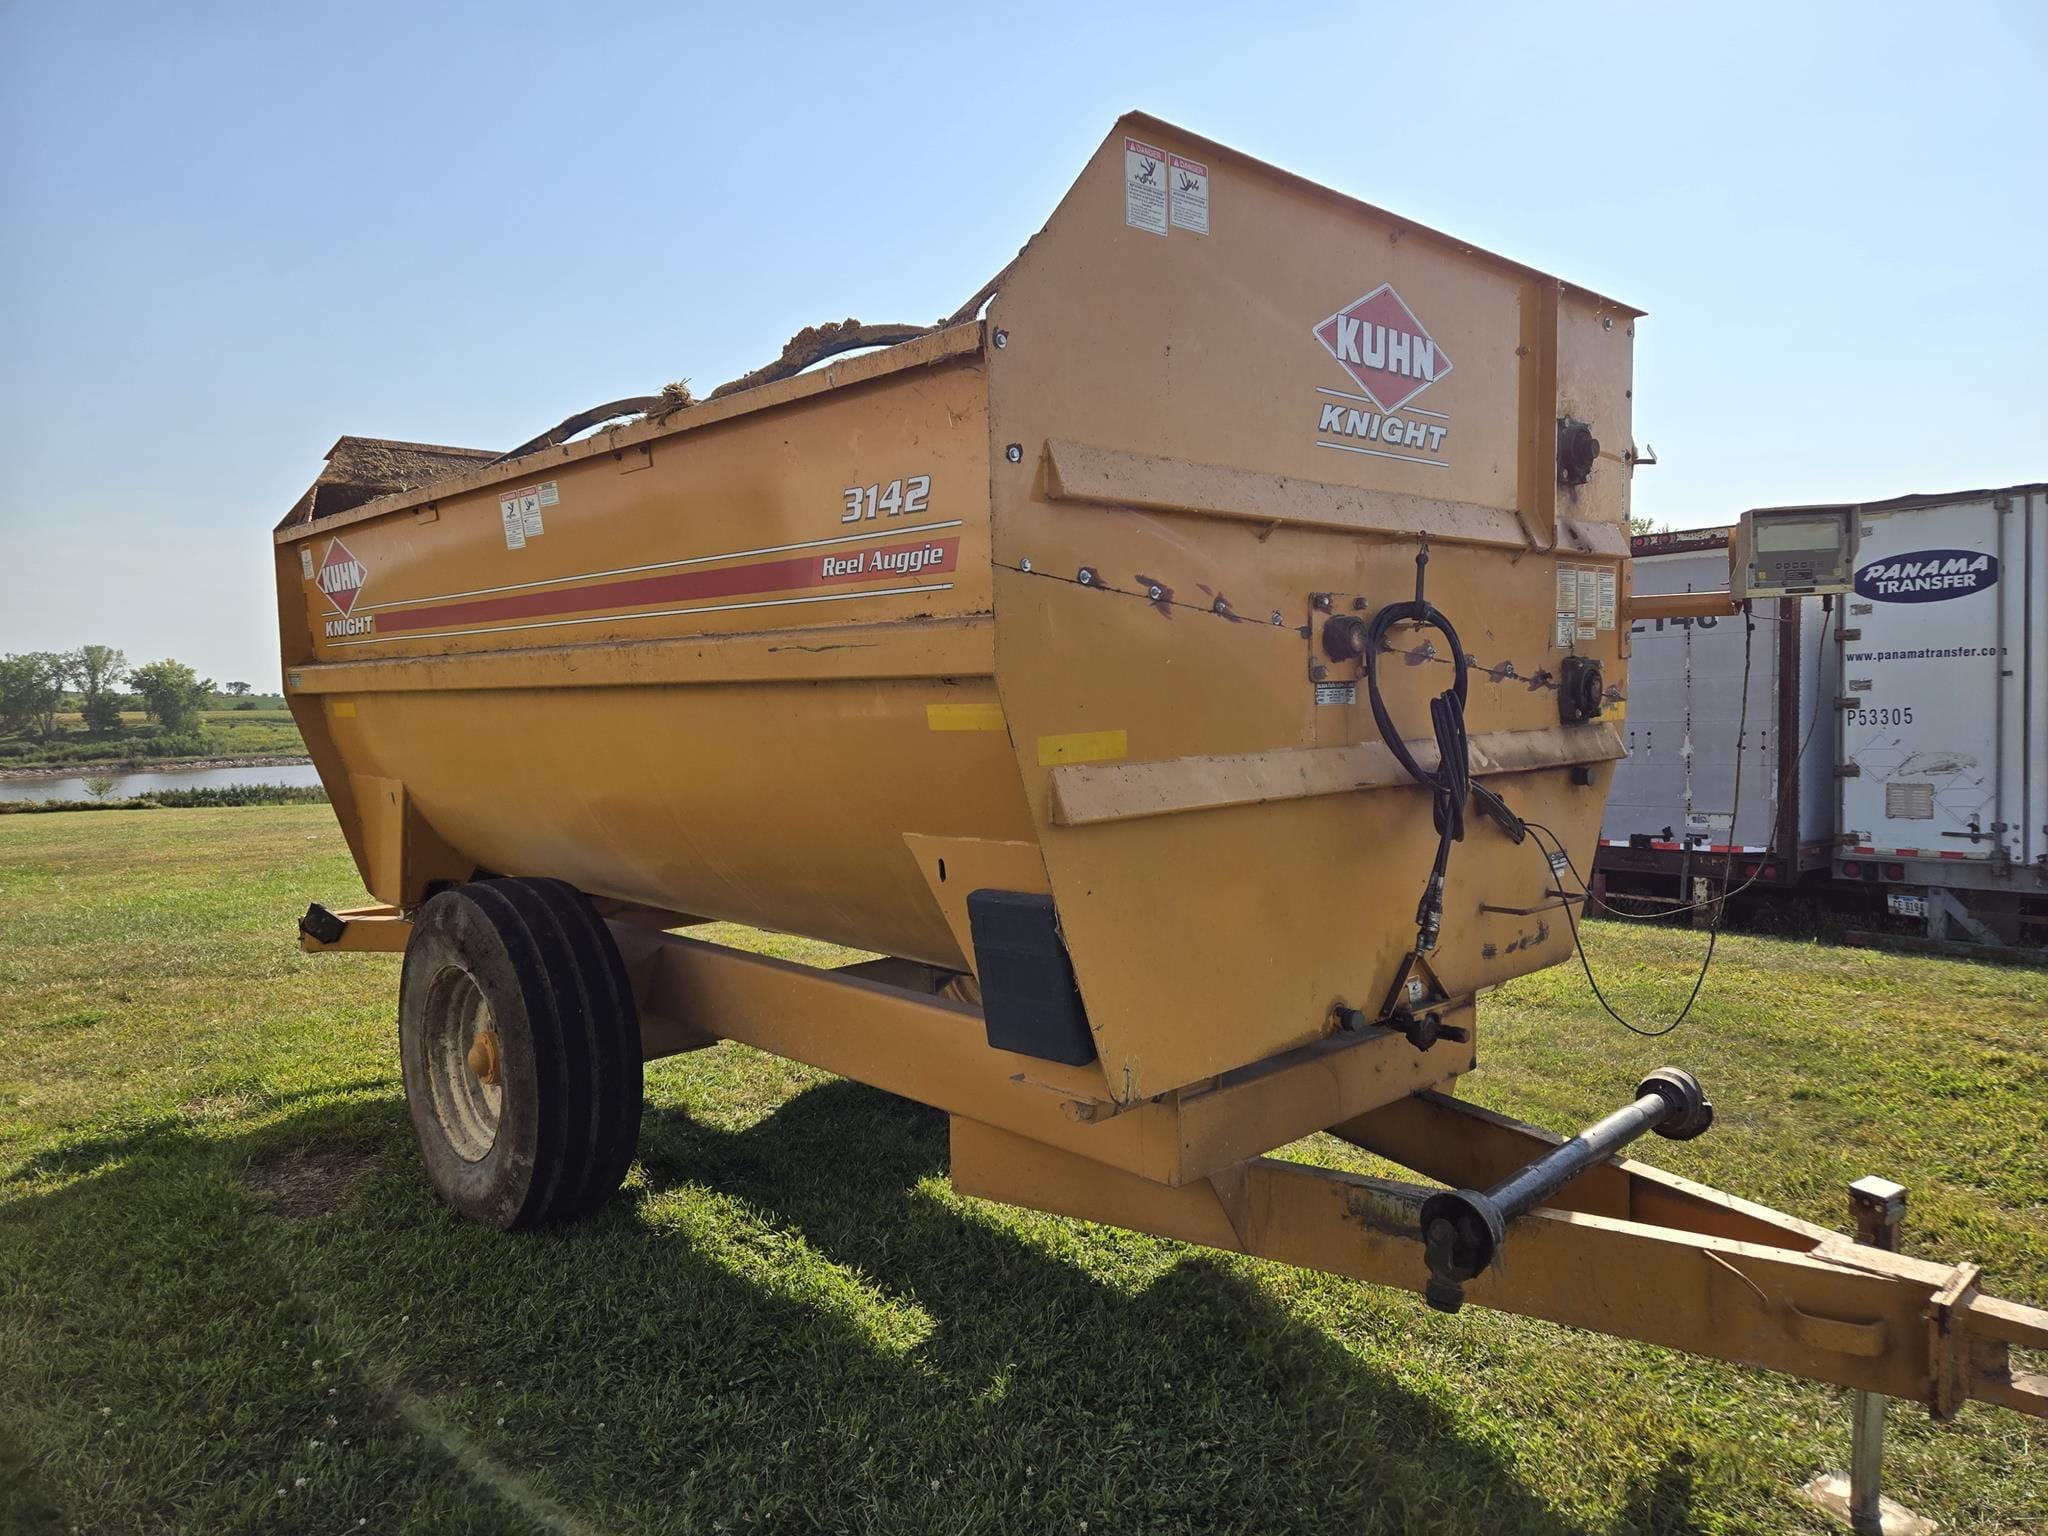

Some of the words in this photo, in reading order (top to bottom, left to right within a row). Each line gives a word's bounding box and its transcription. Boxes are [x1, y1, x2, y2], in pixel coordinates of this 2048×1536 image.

[1336, 314, 1435, 382] KUHN
[1319, 404, 1447, 451] KNIGHT
[841, 474, 931, 523] 3142
[322, 561, 361, 594] KUHN
[822, 552, 864, 579] Reel
[869, 544, 944, 574] Auggie
[1864, 555, 1989, 582] PANAMA
[1876, 574, 1976, 594] TRANSFER
[325, 615, 373, 638] KNIGHT
[1847, 707, 1913, 727] P53305
